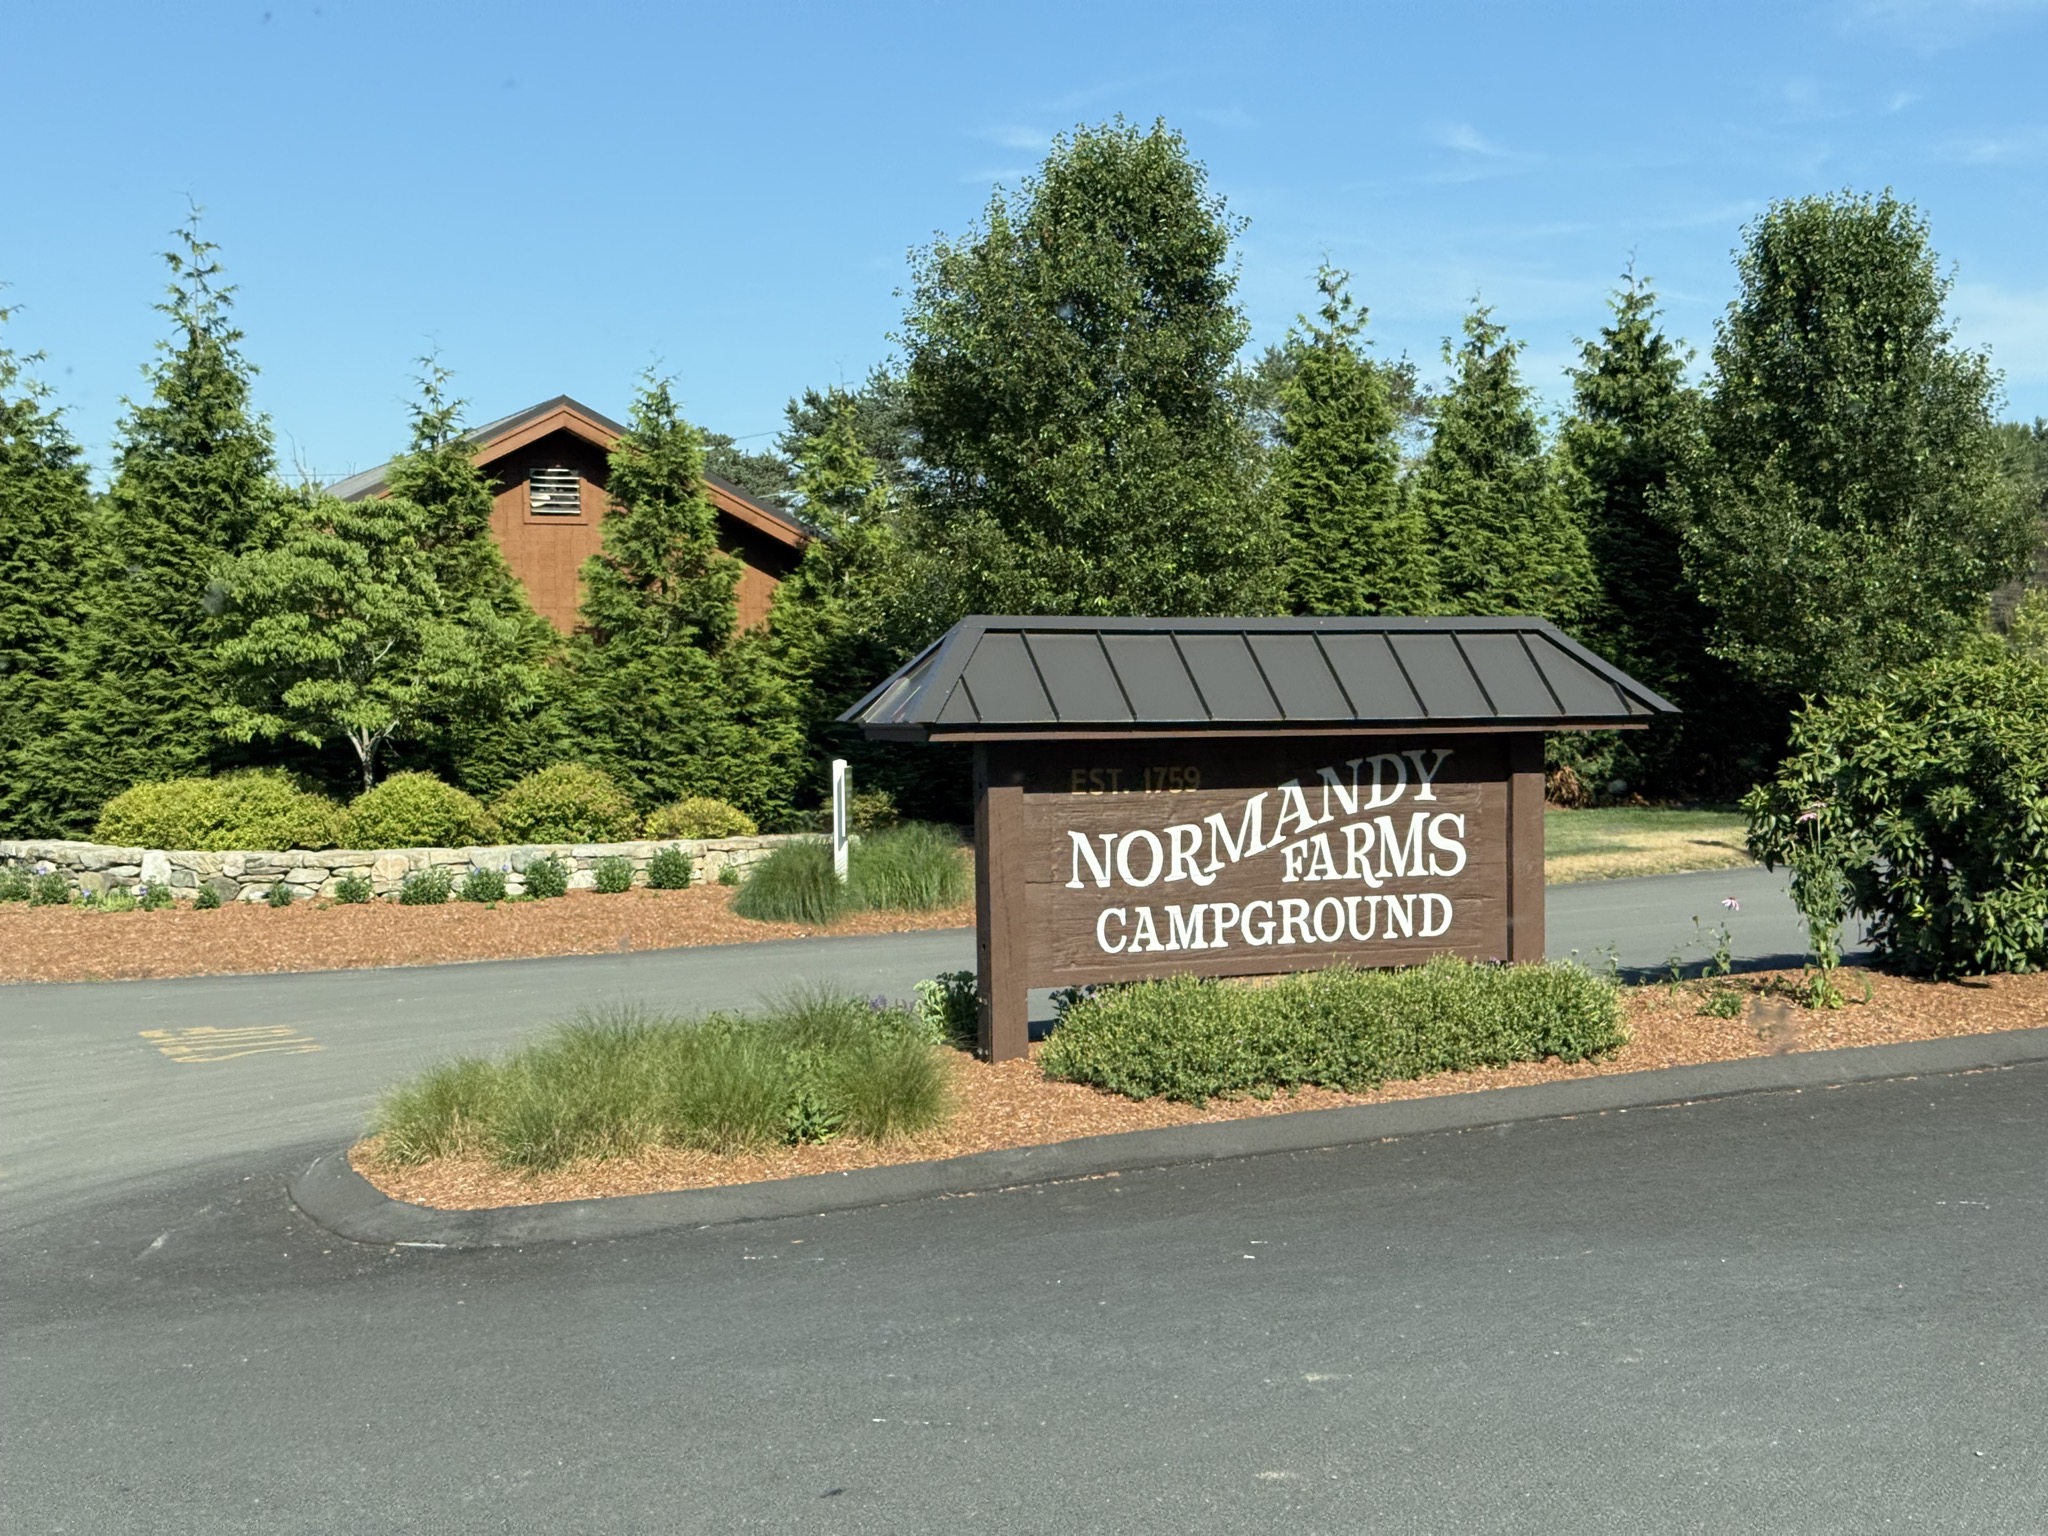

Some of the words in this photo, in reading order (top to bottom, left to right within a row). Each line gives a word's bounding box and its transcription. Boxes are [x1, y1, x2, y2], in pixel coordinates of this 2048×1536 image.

[1071, 768, 1130, 795] EST.
[1143, 765, 1201, 793] 1759
[1065, 749, 1454, 889] NORMANDY
[1281, 811, 1467, 889] FARMS
[1096, 892, 1454, 954] CAMPGROUND
